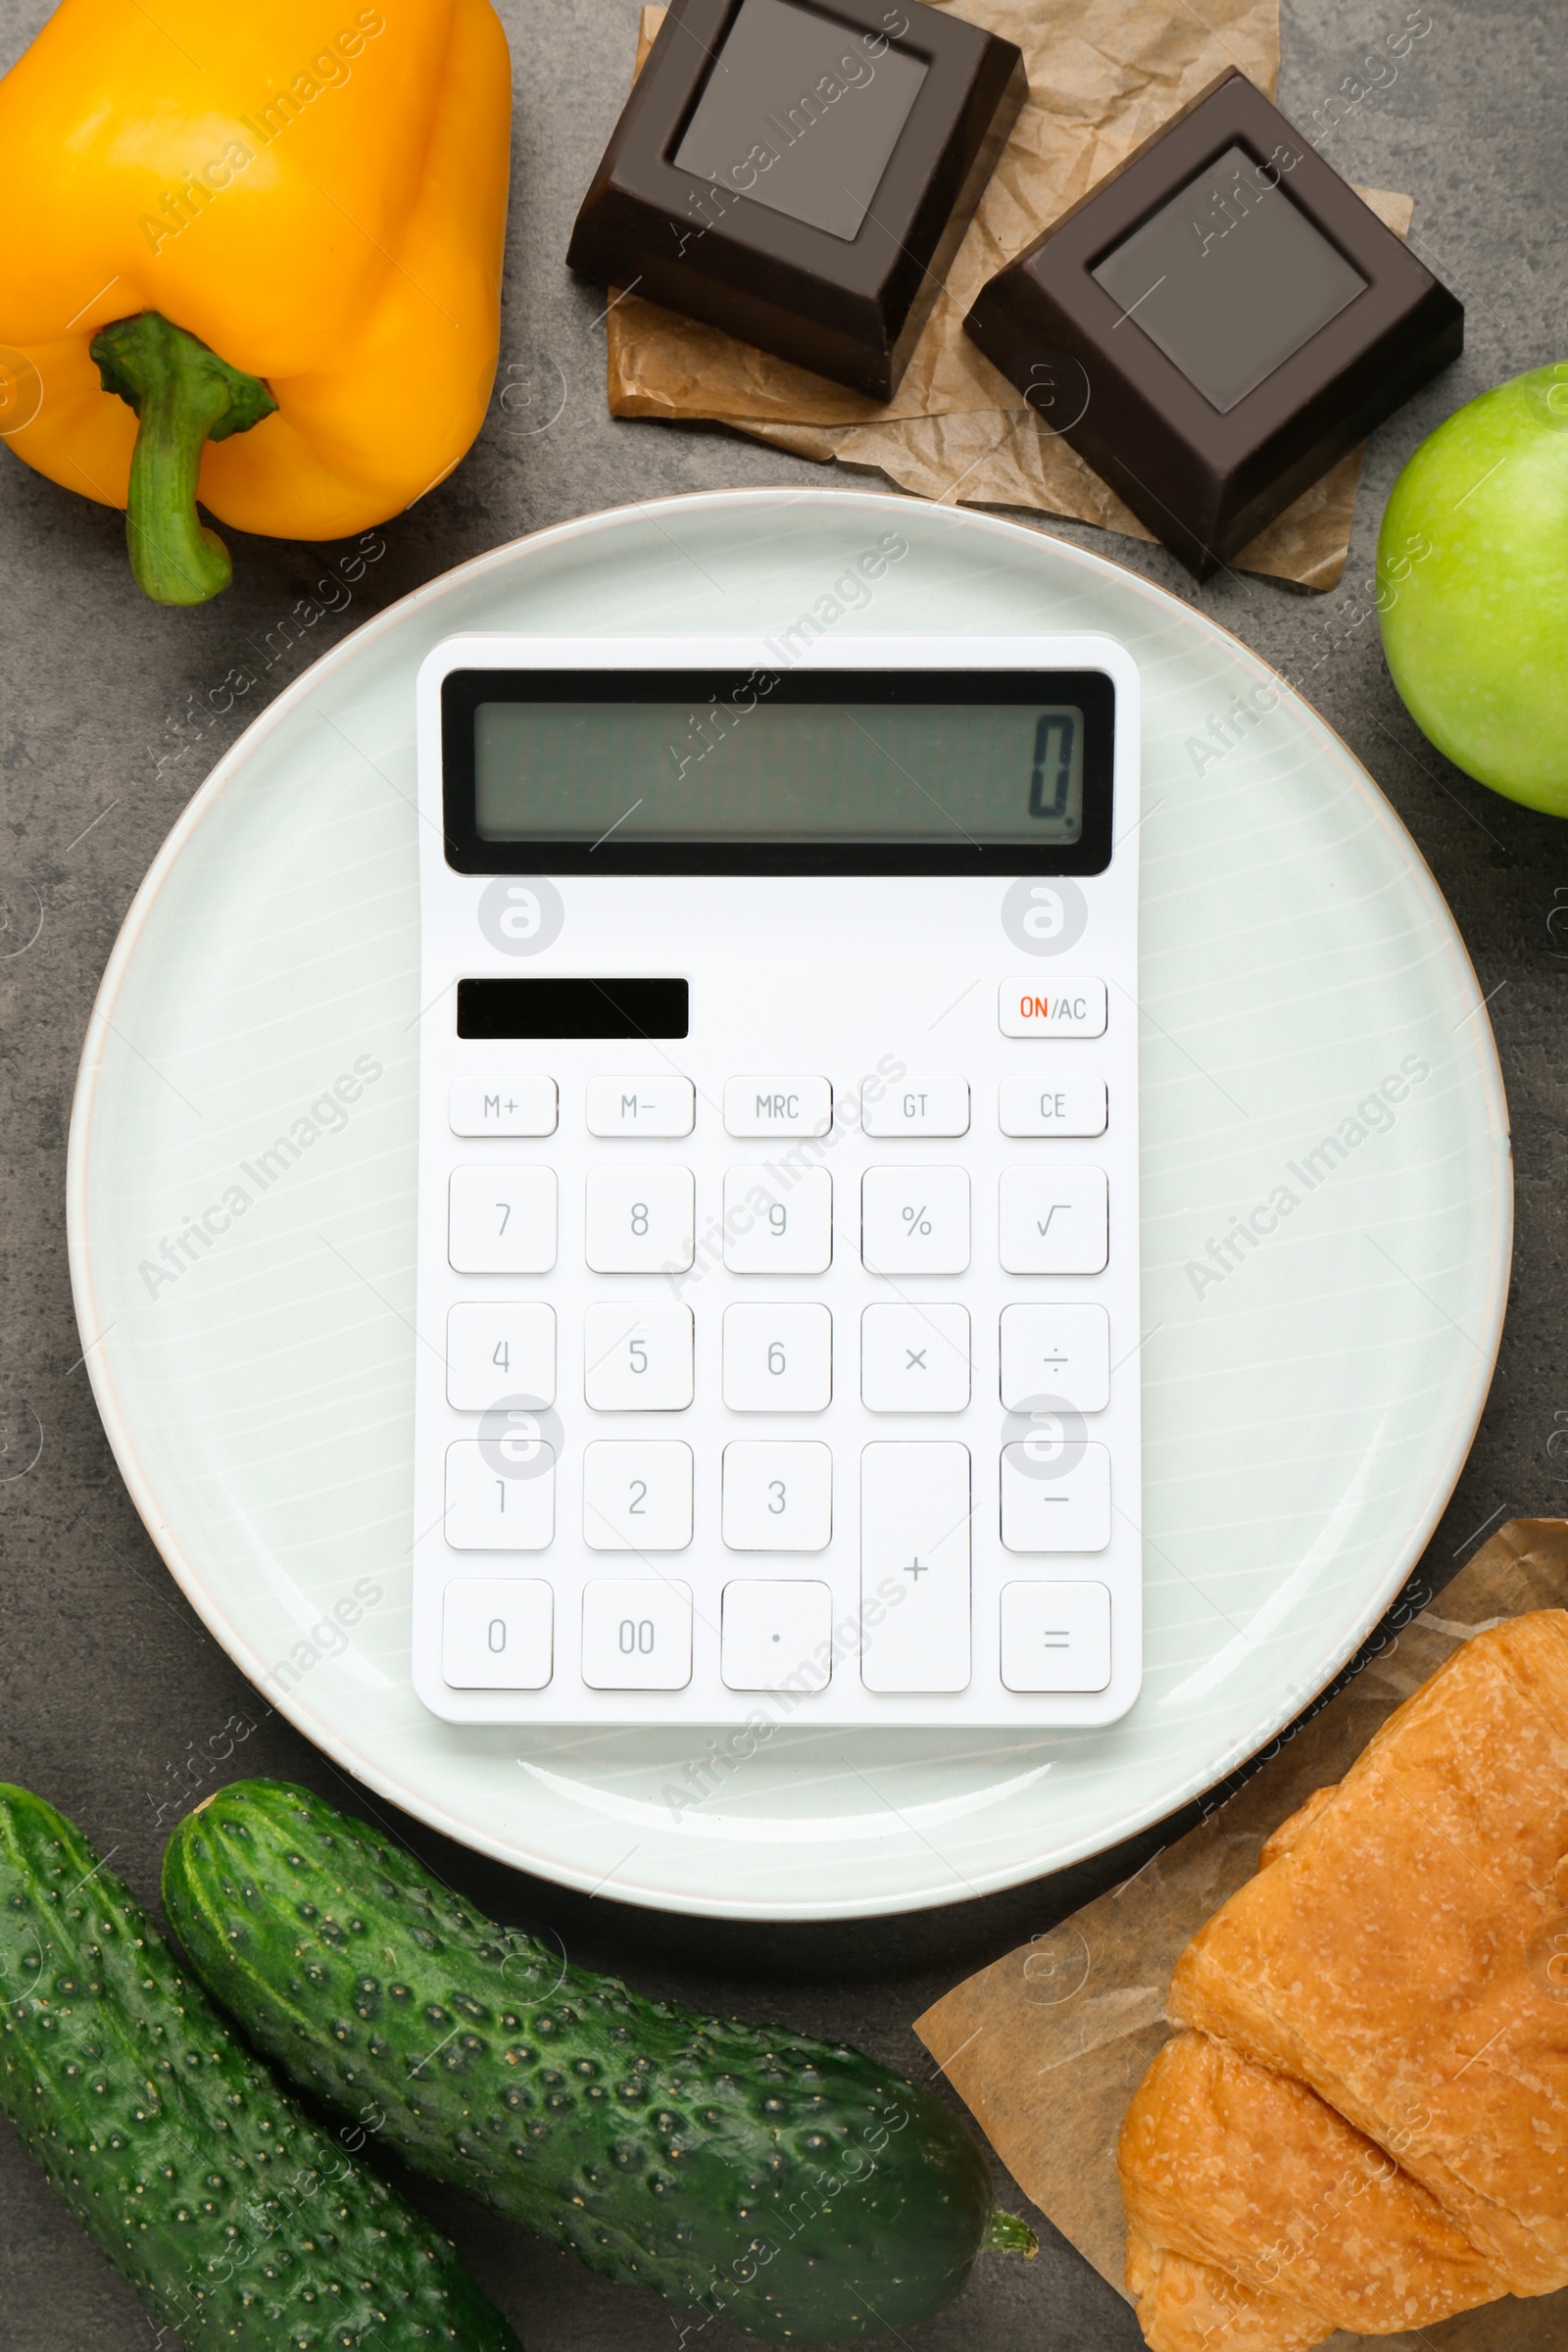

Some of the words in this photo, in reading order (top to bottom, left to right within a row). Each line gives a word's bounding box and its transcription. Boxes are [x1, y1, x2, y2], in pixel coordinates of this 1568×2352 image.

[1019, 995, 1088, 1020] ON/AC
[484, 1094, 519, 1118] M+
[620, 1094, 657, 1118] M-
[756, 1094, 800, 1119] MRC
[903, 1094, 929, 1118] GT
[1040, 1093, 1066, 1118] CE
[495, 1202, 512, 1237] 7
[630, 1202, 649, 1237] 8
[768, 1202, 787, 1237] 9
[902, 1205, 932, 1237] %
[492, 1341, 511, 1374] 4
[629, 1340, 648, 1375] 5
[767, 1341, 786, 1376] 6
[495, 1480, 506, 1514] 1
[628, 1480, 648, 1515] 2
[767, 1480, 787, 1515] 3
[487, 1618, 507, 1654] 0
[618, 1619, 655, 1655] 00
